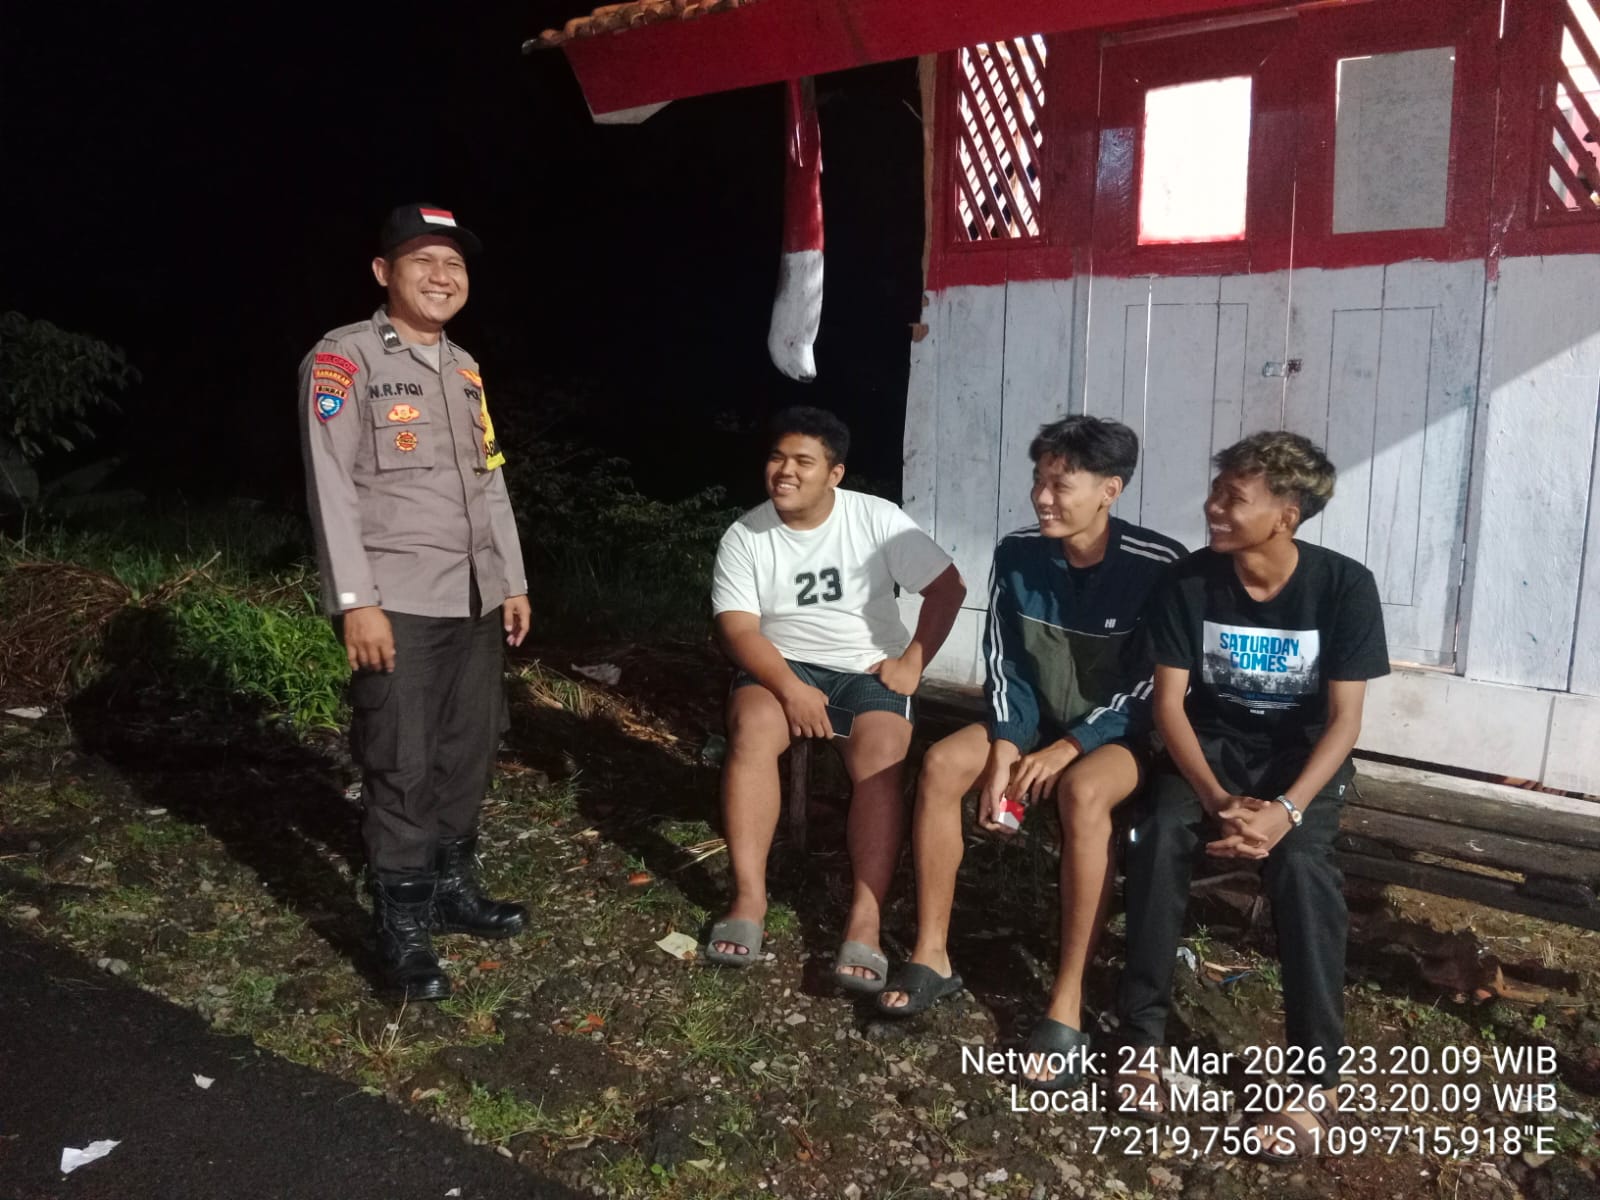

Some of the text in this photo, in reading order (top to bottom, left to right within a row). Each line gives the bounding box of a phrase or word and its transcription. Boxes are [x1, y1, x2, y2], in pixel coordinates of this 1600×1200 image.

[368, 382, 424, 399] N.R.FIQI
[794, 567, 843, 606] 23
[1219, 632, 1300, 657] SATURDAY
[1230, 651, 1288, 673] COMES
